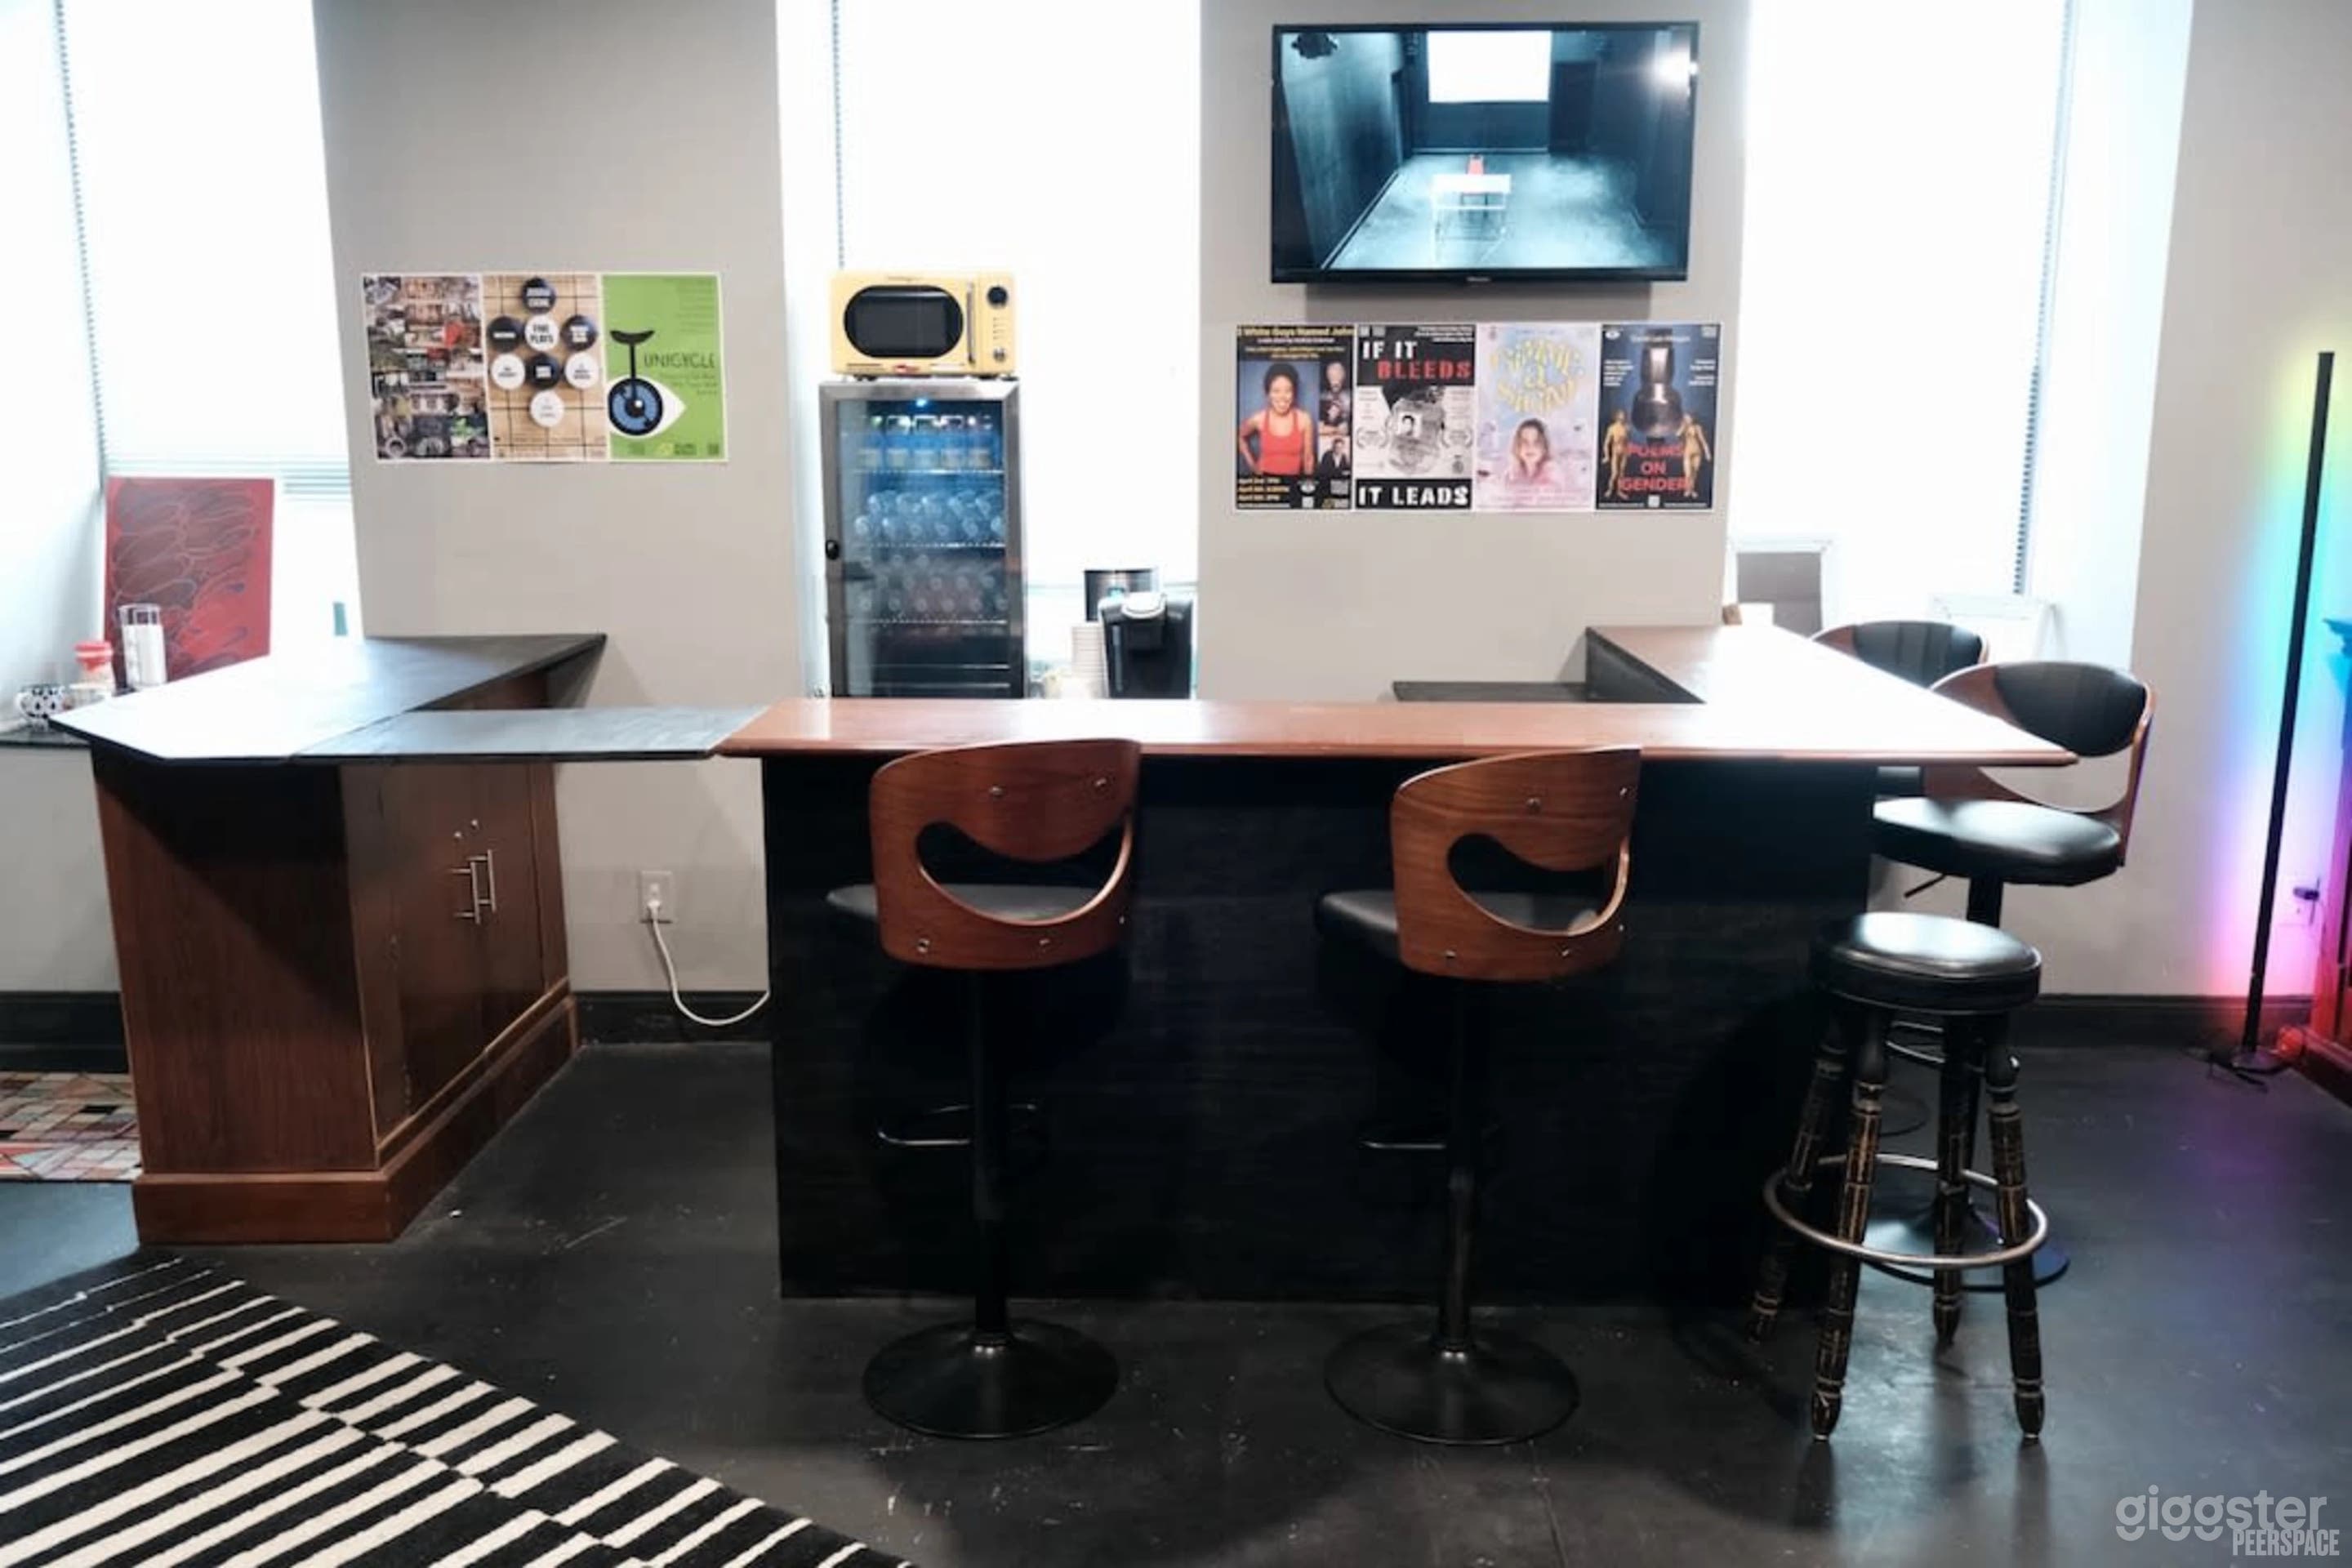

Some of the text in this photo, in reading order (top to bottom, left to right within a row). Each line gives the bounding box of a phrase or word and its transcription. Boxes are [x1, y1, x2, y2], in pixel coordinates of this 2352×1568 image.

[1362, 341, 1418, 359] IF IT
[644, 352, 715, 368] UNICYCLE
[1377, 360, 1472, 379] BLEEDS
[1640, 461, 1666, 474] ON
[1618, 477, 1690, 491] GENDER
[1358, 487, 1383, 506] IT
[1392, 486, 1469, 506] LEADS
